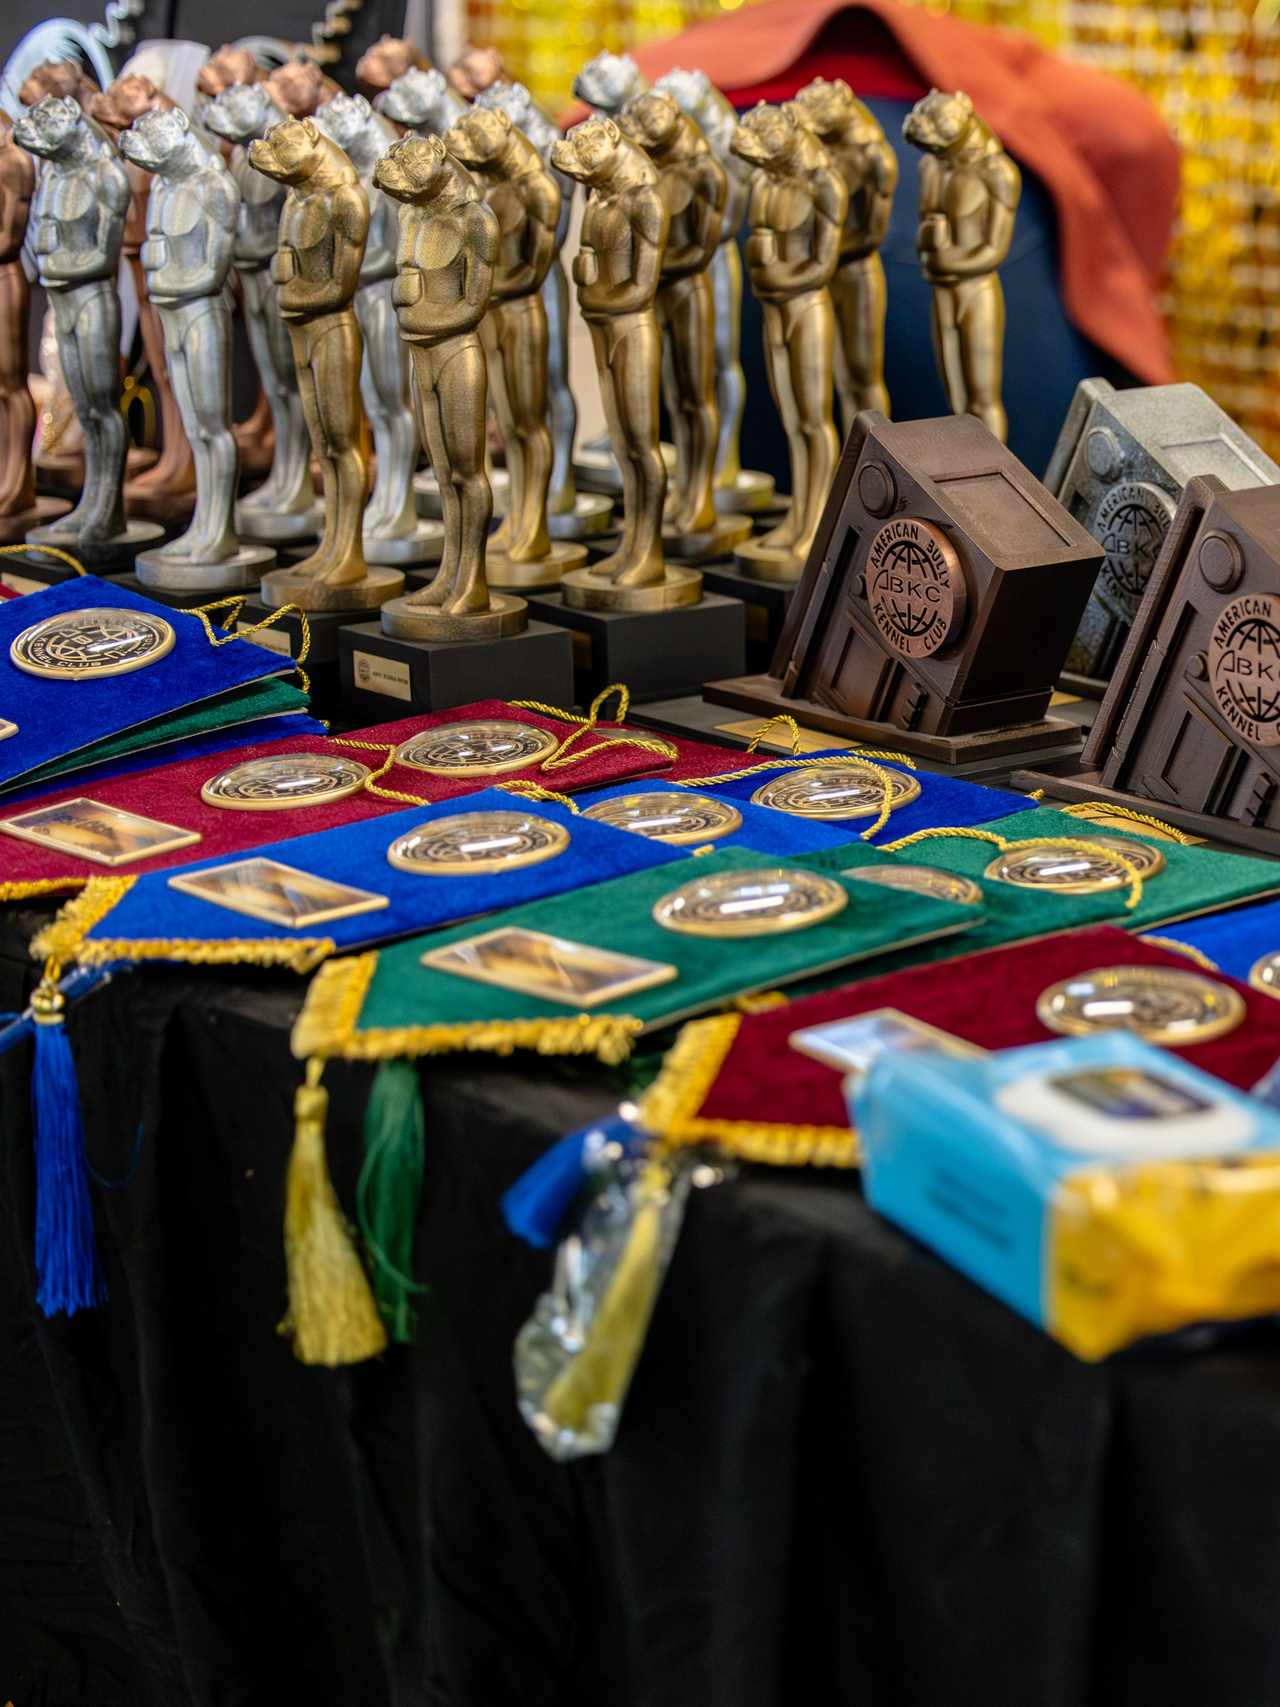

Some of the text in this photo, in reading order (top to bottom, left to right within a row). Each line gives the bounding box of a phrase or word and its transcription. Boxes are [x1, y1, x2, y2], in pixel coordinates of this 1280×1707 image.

[870, 522, 950, 589] AMERICAN BULLY
[872, 569, 941, 603] ABKC
[872, 602, 947, 654] KENNEL CLUB
[1214, 599, 1272, 649] AMERICAN
[1216, 686, 1261, 741] KENNEL
